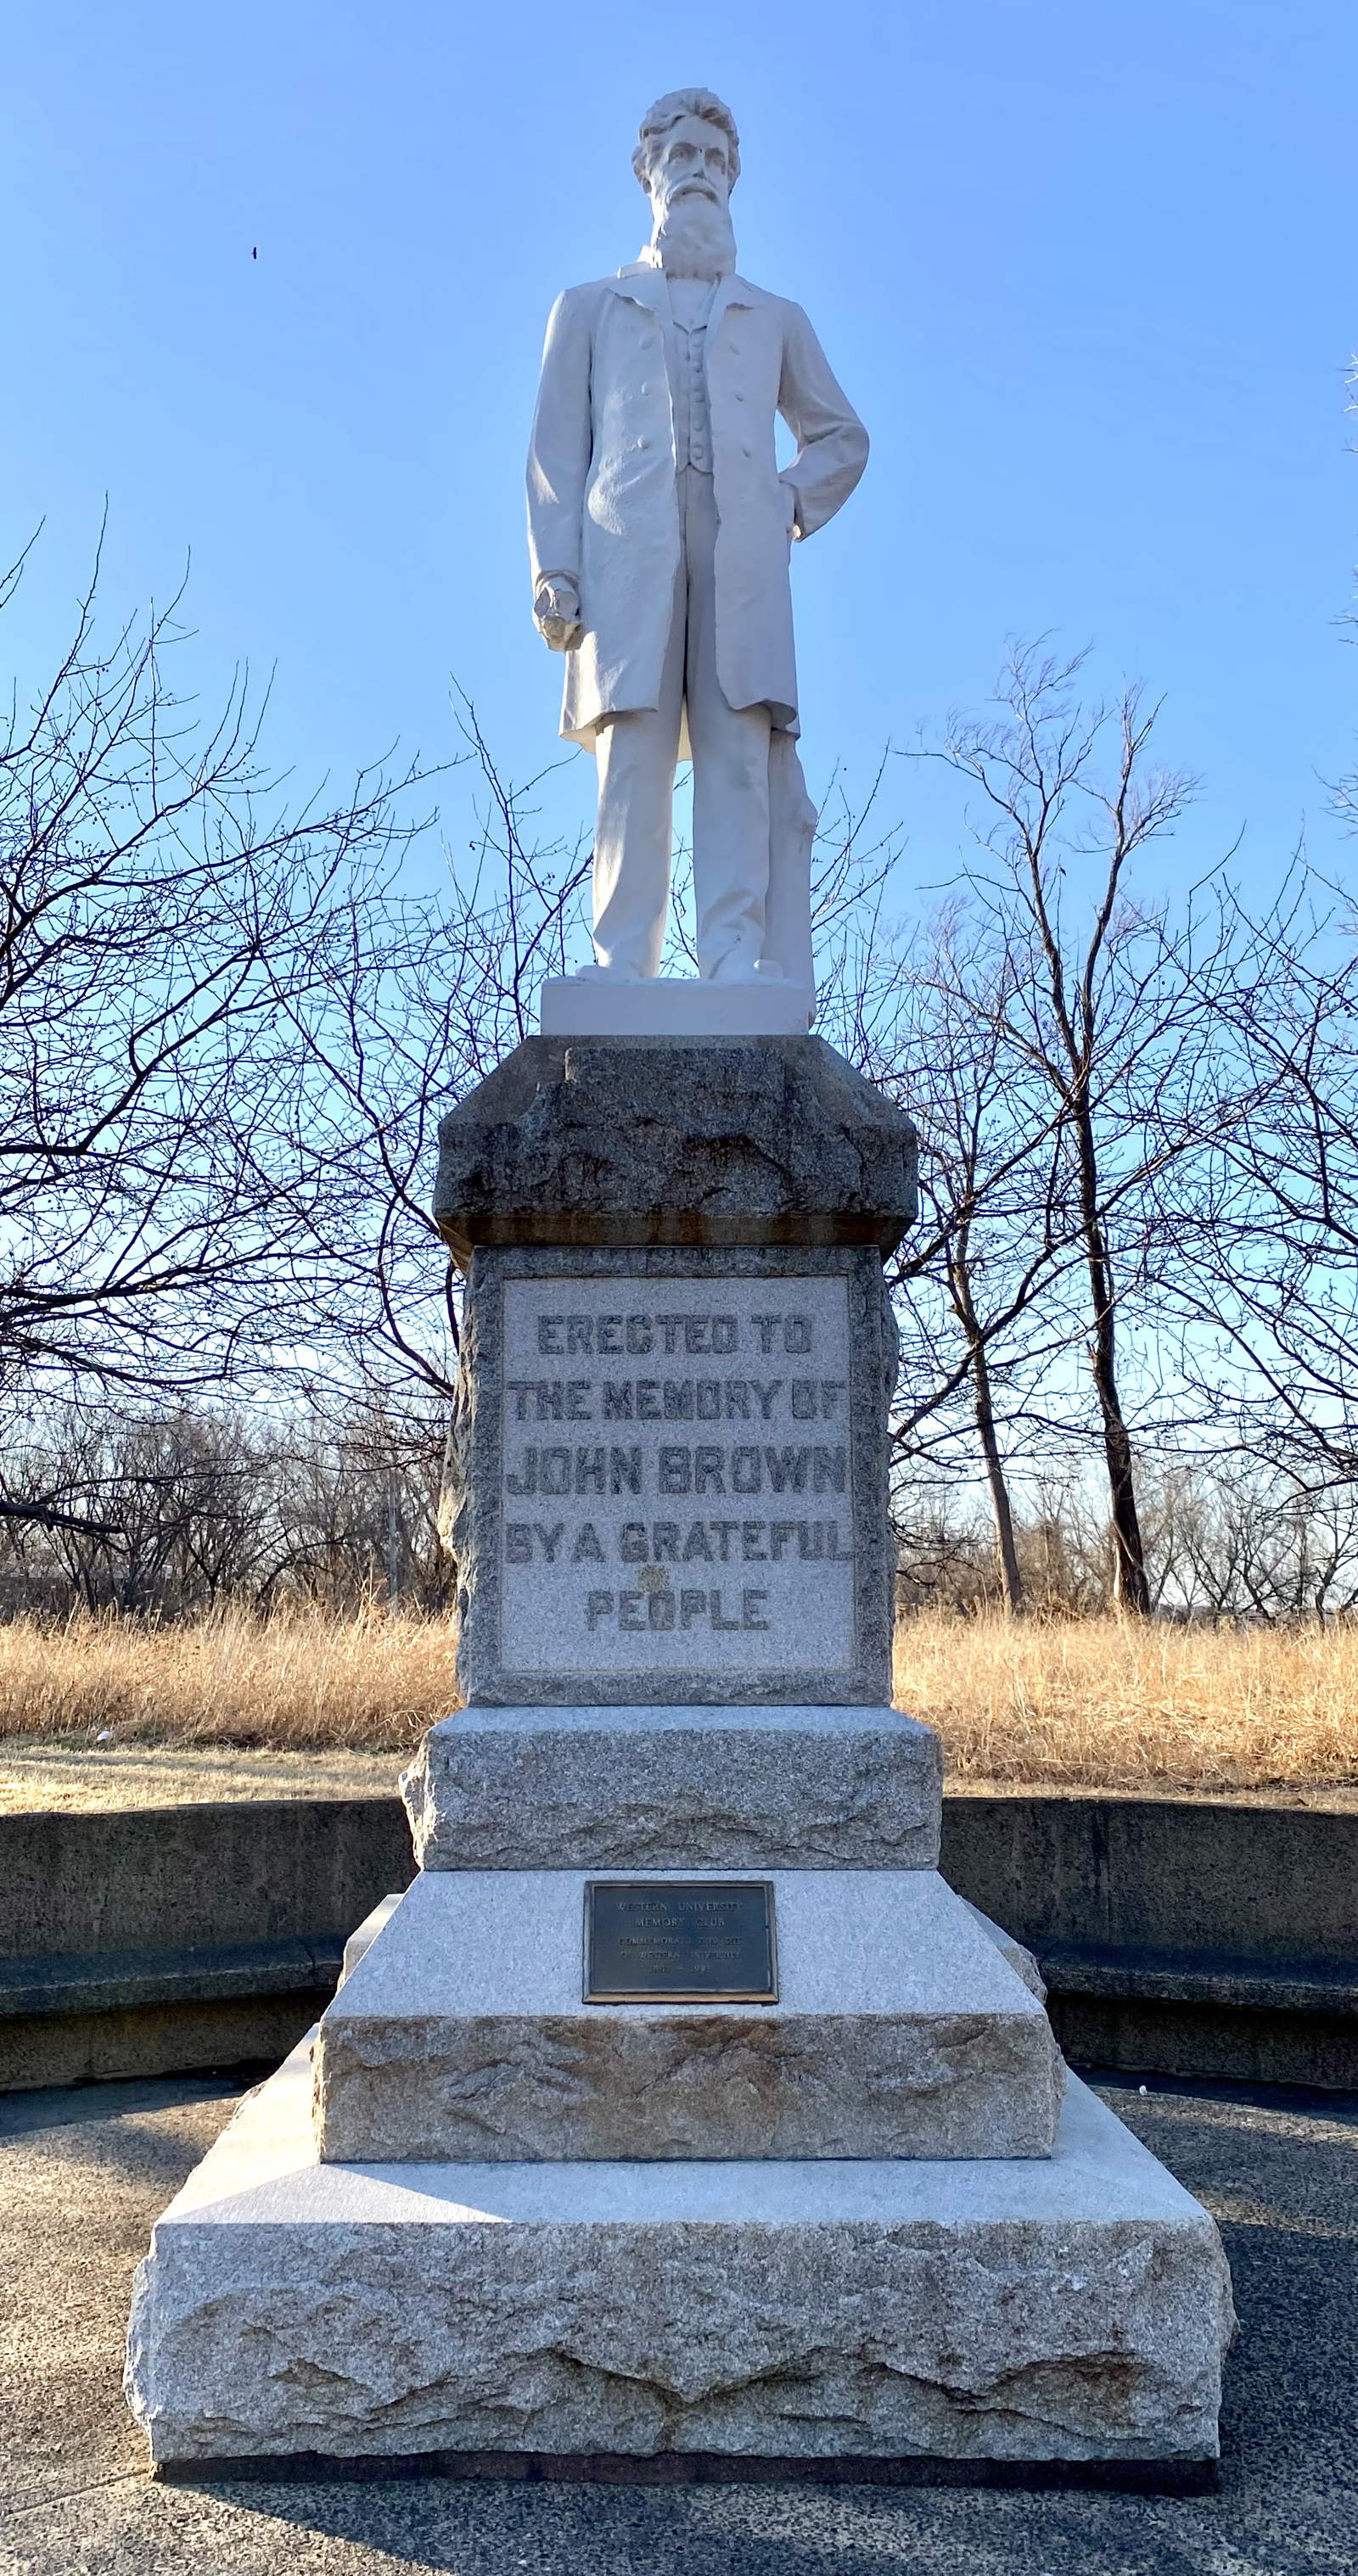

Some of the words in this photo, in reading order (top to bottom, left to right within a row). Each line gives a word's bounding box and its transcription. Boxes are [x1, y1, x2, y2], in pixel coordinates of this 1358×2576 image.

[537, 1314, 738, 1354] ERECTED
[751, 1313, 811, 1353] TO
[508, 1380, 592, 1420] THE
[603, 1380, 782, 1420] MEMORY
[792, 1380, 846, 1420] OF
[508, 1446, 642, 1495] JOHN
[659, 1446, 846, 1494] BROWN
[508, 1522, 564, 1563] BY
[570, 1521, 605, 1563] A
[620, 1520, 855, 1563] GRATEFUL
[586, 1589, 768, 1632] PEOPLE
[617, 1901, 667, 1912] WESTERN
[678, 1901, 741, 1912] UNIVERSITY
[636, 1918, 685, 1927] MEMORY
